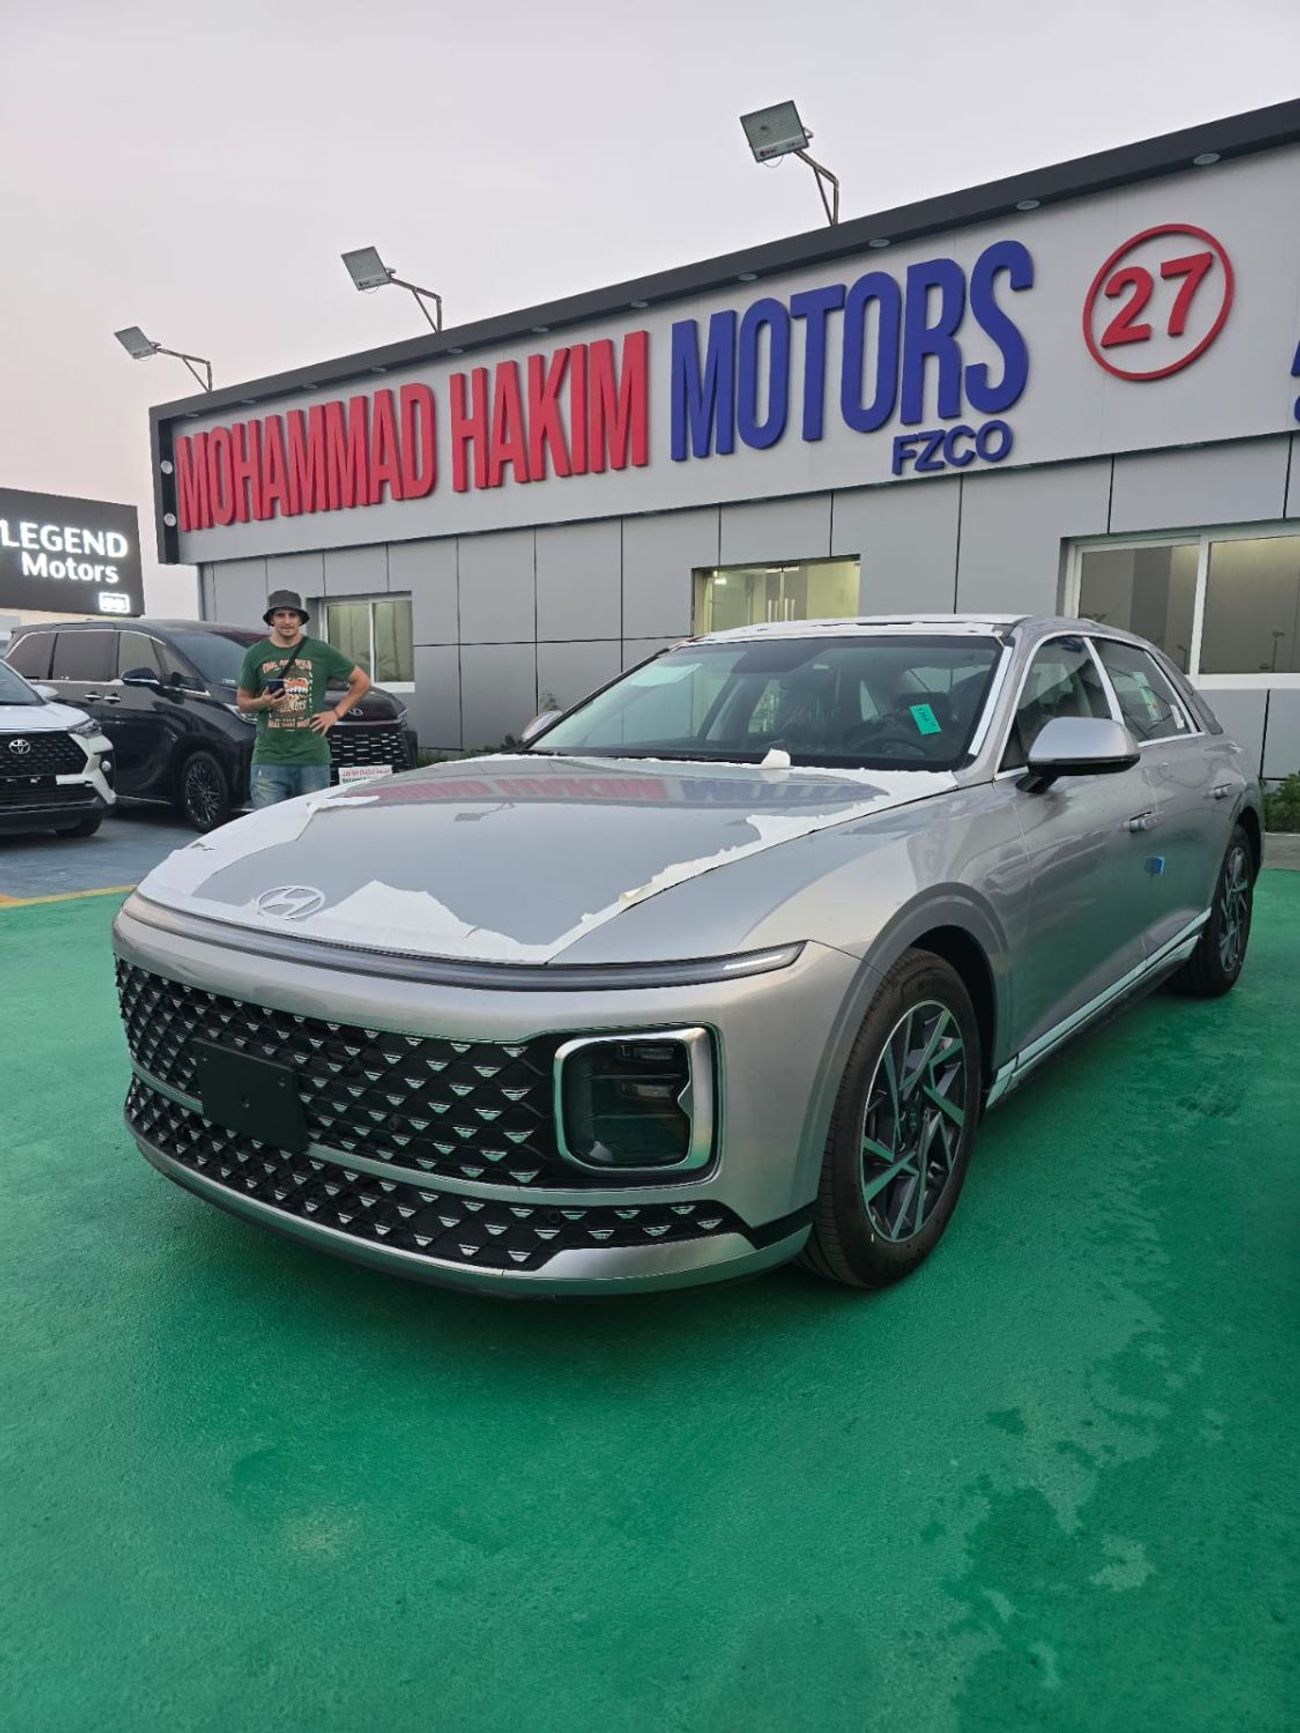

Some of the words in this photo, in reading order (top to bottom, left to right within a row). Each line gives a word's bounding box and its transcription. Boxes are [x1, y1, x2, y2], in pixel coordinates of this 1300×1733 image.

[1100, 252, 1214, 348] 27
[176, 383, 437, 532] MOHAMMAD
[449, 330, 650, 492] HAKIM
[671, 240, 1034, 463] MOTORS
[892, 420, 1014, 475] FZCO
[0, 518, 128, 558] LEGEND
[21, 551, 119, 583] Motors
